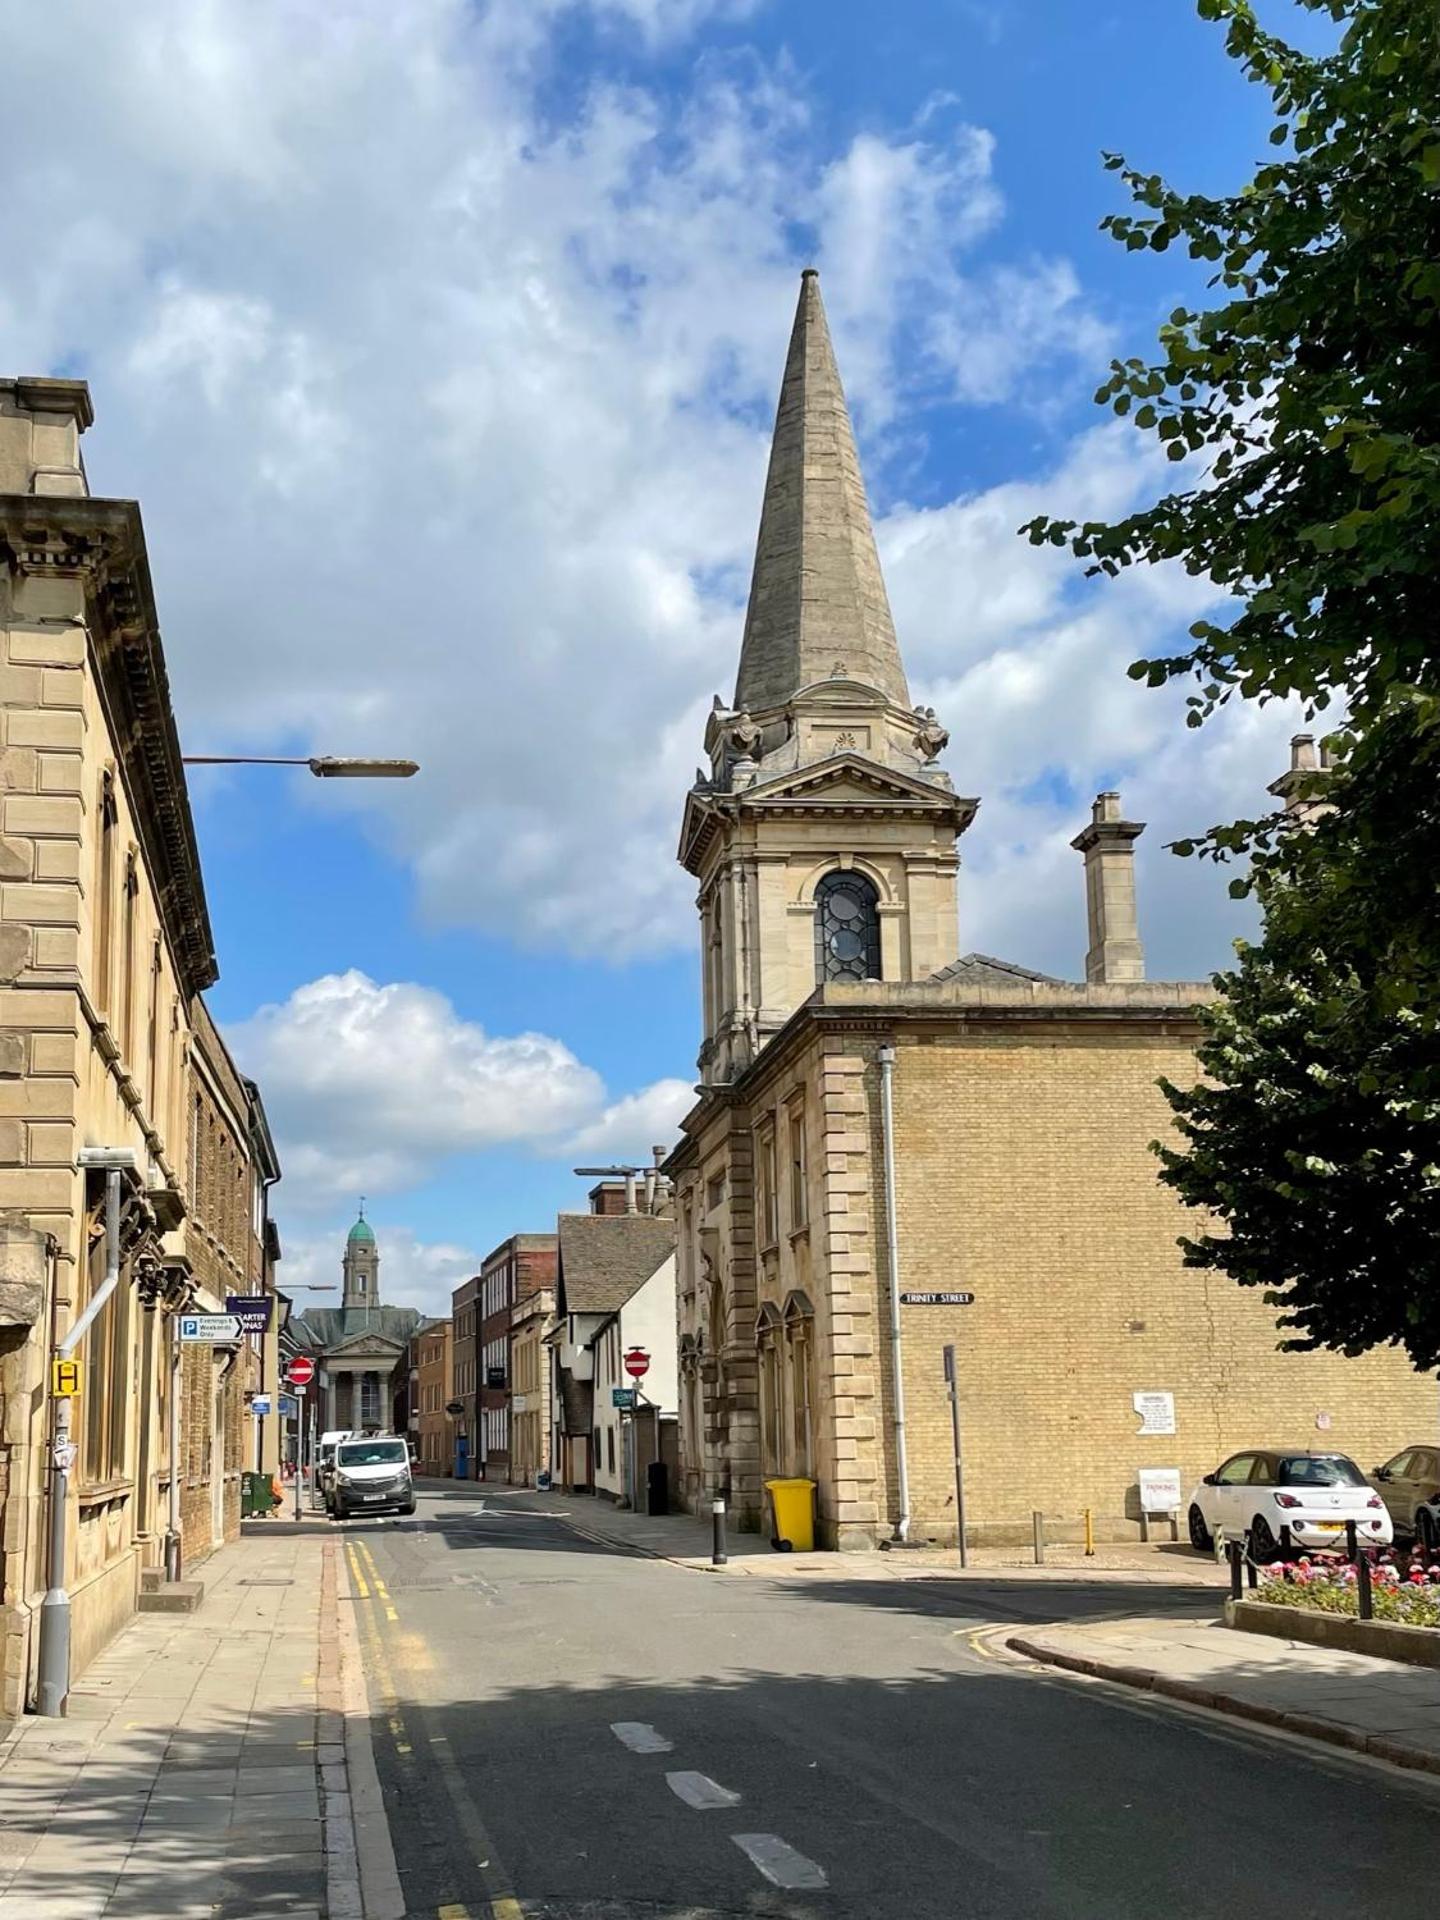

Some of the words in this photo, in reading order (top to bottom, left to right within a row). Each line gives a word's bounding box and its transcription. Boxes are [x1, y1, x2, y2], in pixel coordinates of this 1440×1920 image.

[906, 1294, 937, 1302] TRINITY
[941, 1294, 969, 1302] STREET
[186, 1322, 195, 1334] P
[57, 1363, 78, 1392] H
[58, 1435, 66, 1445] S
